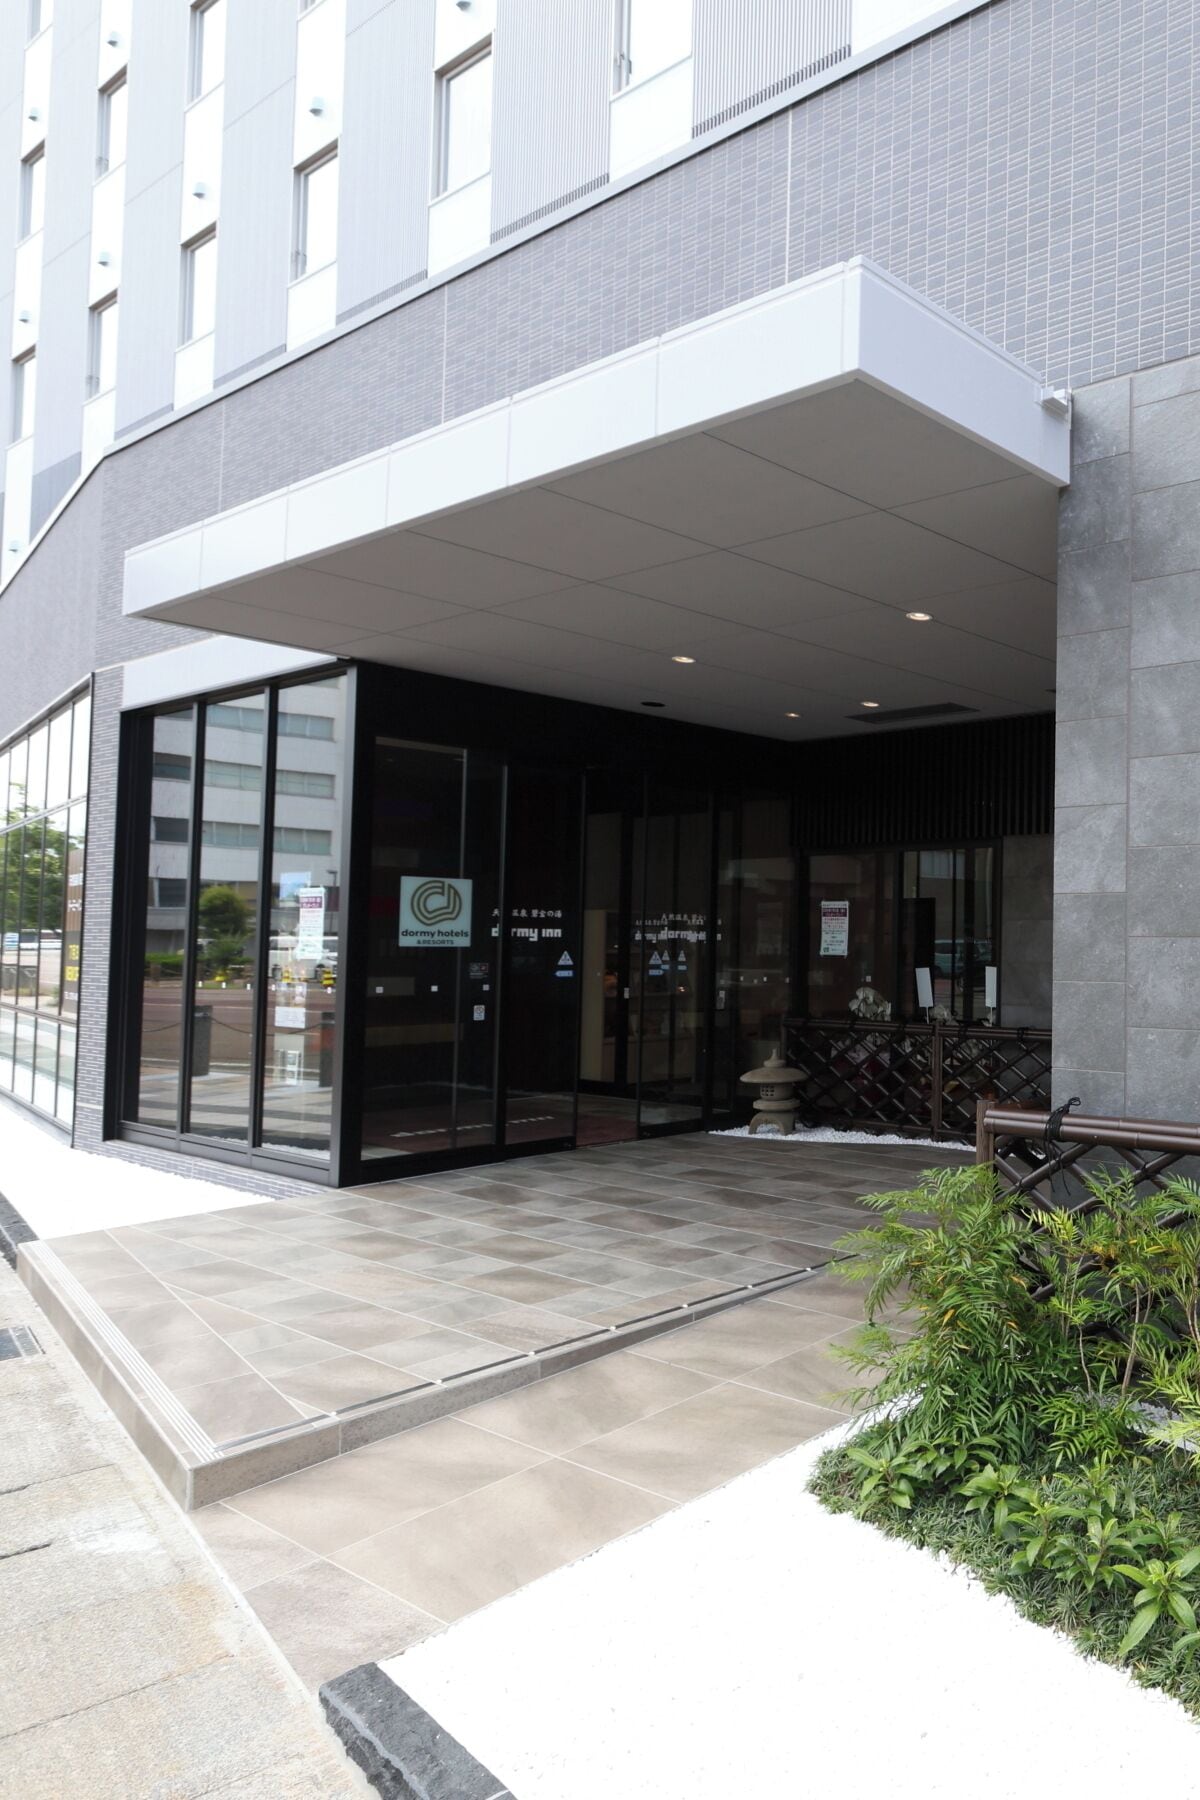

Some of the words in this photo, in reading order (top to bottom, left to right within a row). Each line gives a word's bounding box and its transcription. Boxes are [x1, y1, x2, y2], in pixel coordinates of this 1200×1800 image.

[401, 929, 436, 939] dormy
[437, 929, 470, 938] hotels
[491, 923, 538, 942] drmy
